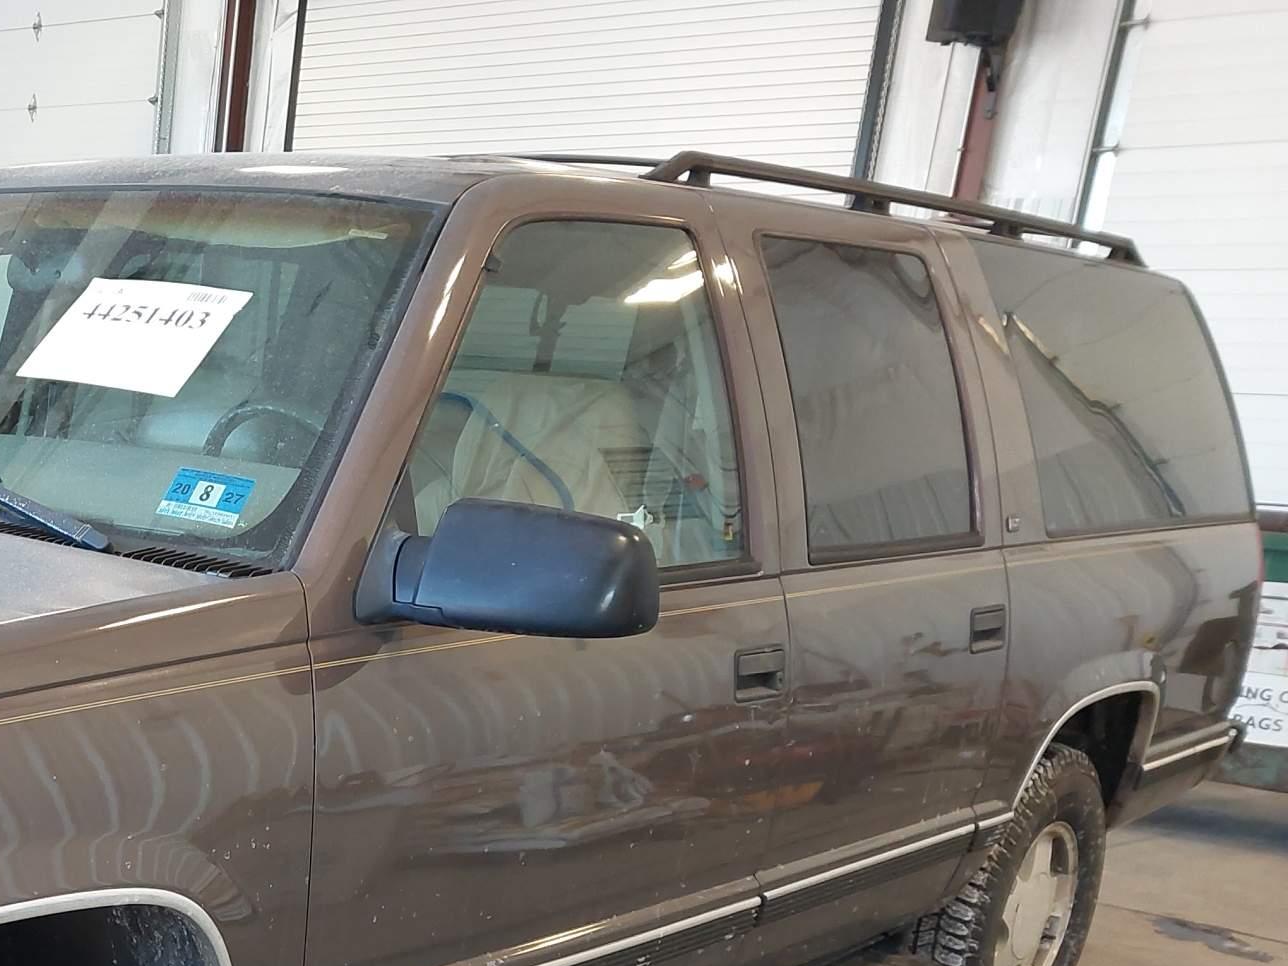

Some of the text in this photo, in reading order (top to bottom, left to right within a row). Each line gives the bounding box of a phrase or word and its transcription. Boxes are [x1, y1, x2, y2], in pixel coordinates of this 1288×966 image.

[83, 303, 211, 329] 44251403
[172, 482, 246, 505] 20 8 27
